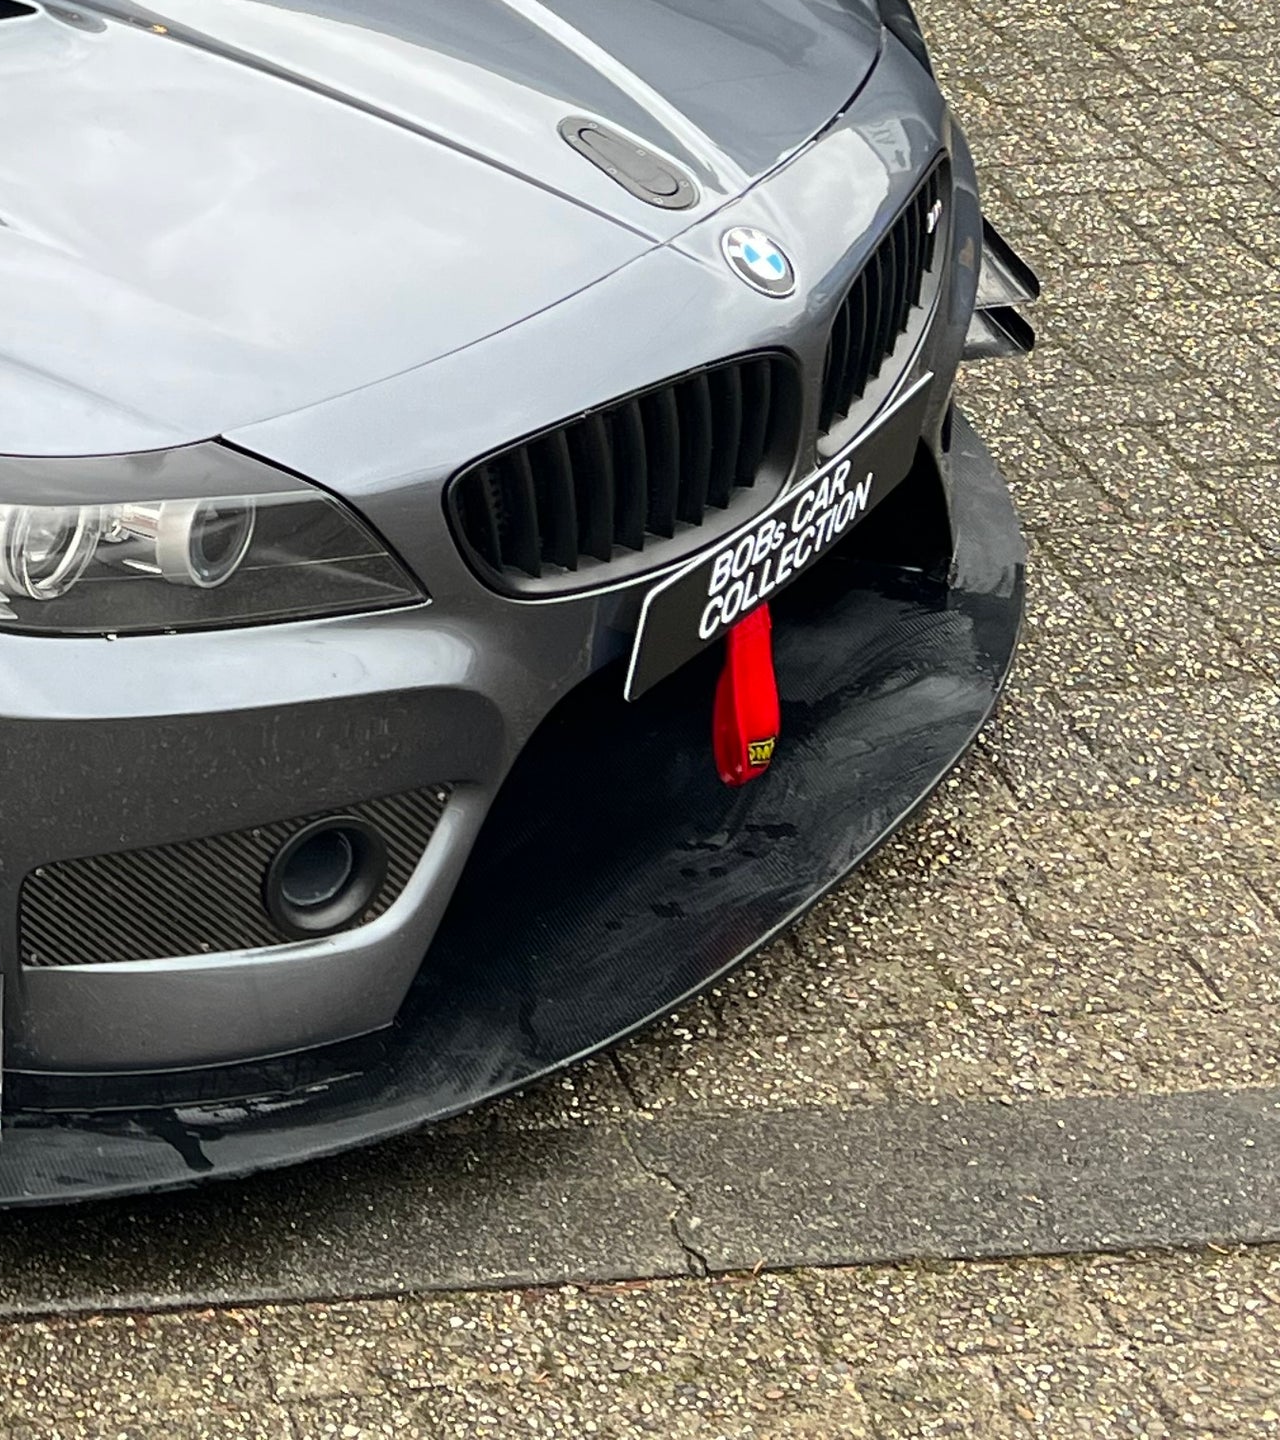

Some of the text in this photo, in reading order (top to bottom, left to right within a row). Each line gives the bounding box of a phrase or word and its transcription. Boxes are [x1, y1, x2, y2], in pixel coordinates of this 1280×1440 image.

[698, 472, 873, 640] COLLECTION
[708, 460, 852, 597] BOBs CAR
